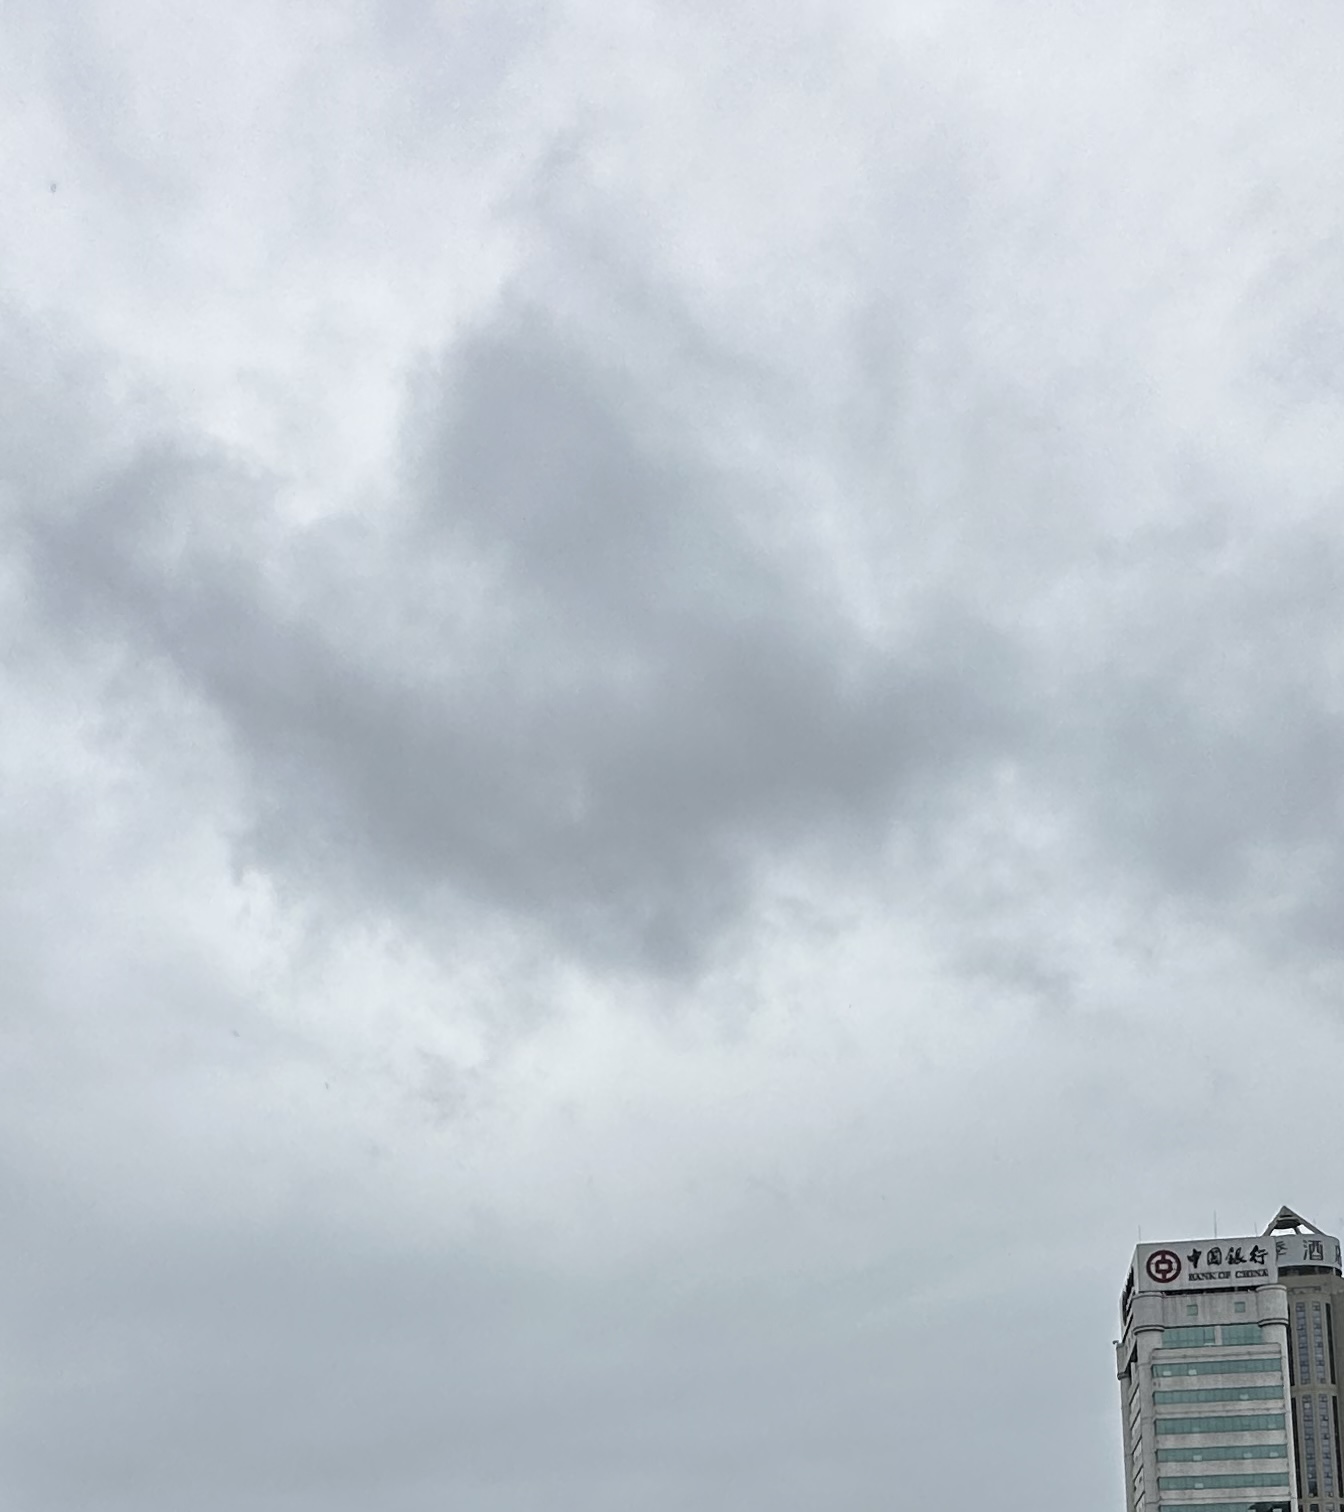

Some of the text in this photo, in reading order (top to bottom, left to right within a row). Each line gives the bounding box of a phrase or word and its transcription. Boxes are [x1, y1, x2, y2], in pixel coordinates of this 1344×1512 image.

[1187, 1245, 1269, 1269] 中国银行
[1188, 1268, 1269, 1282] BANK OF CHINA
